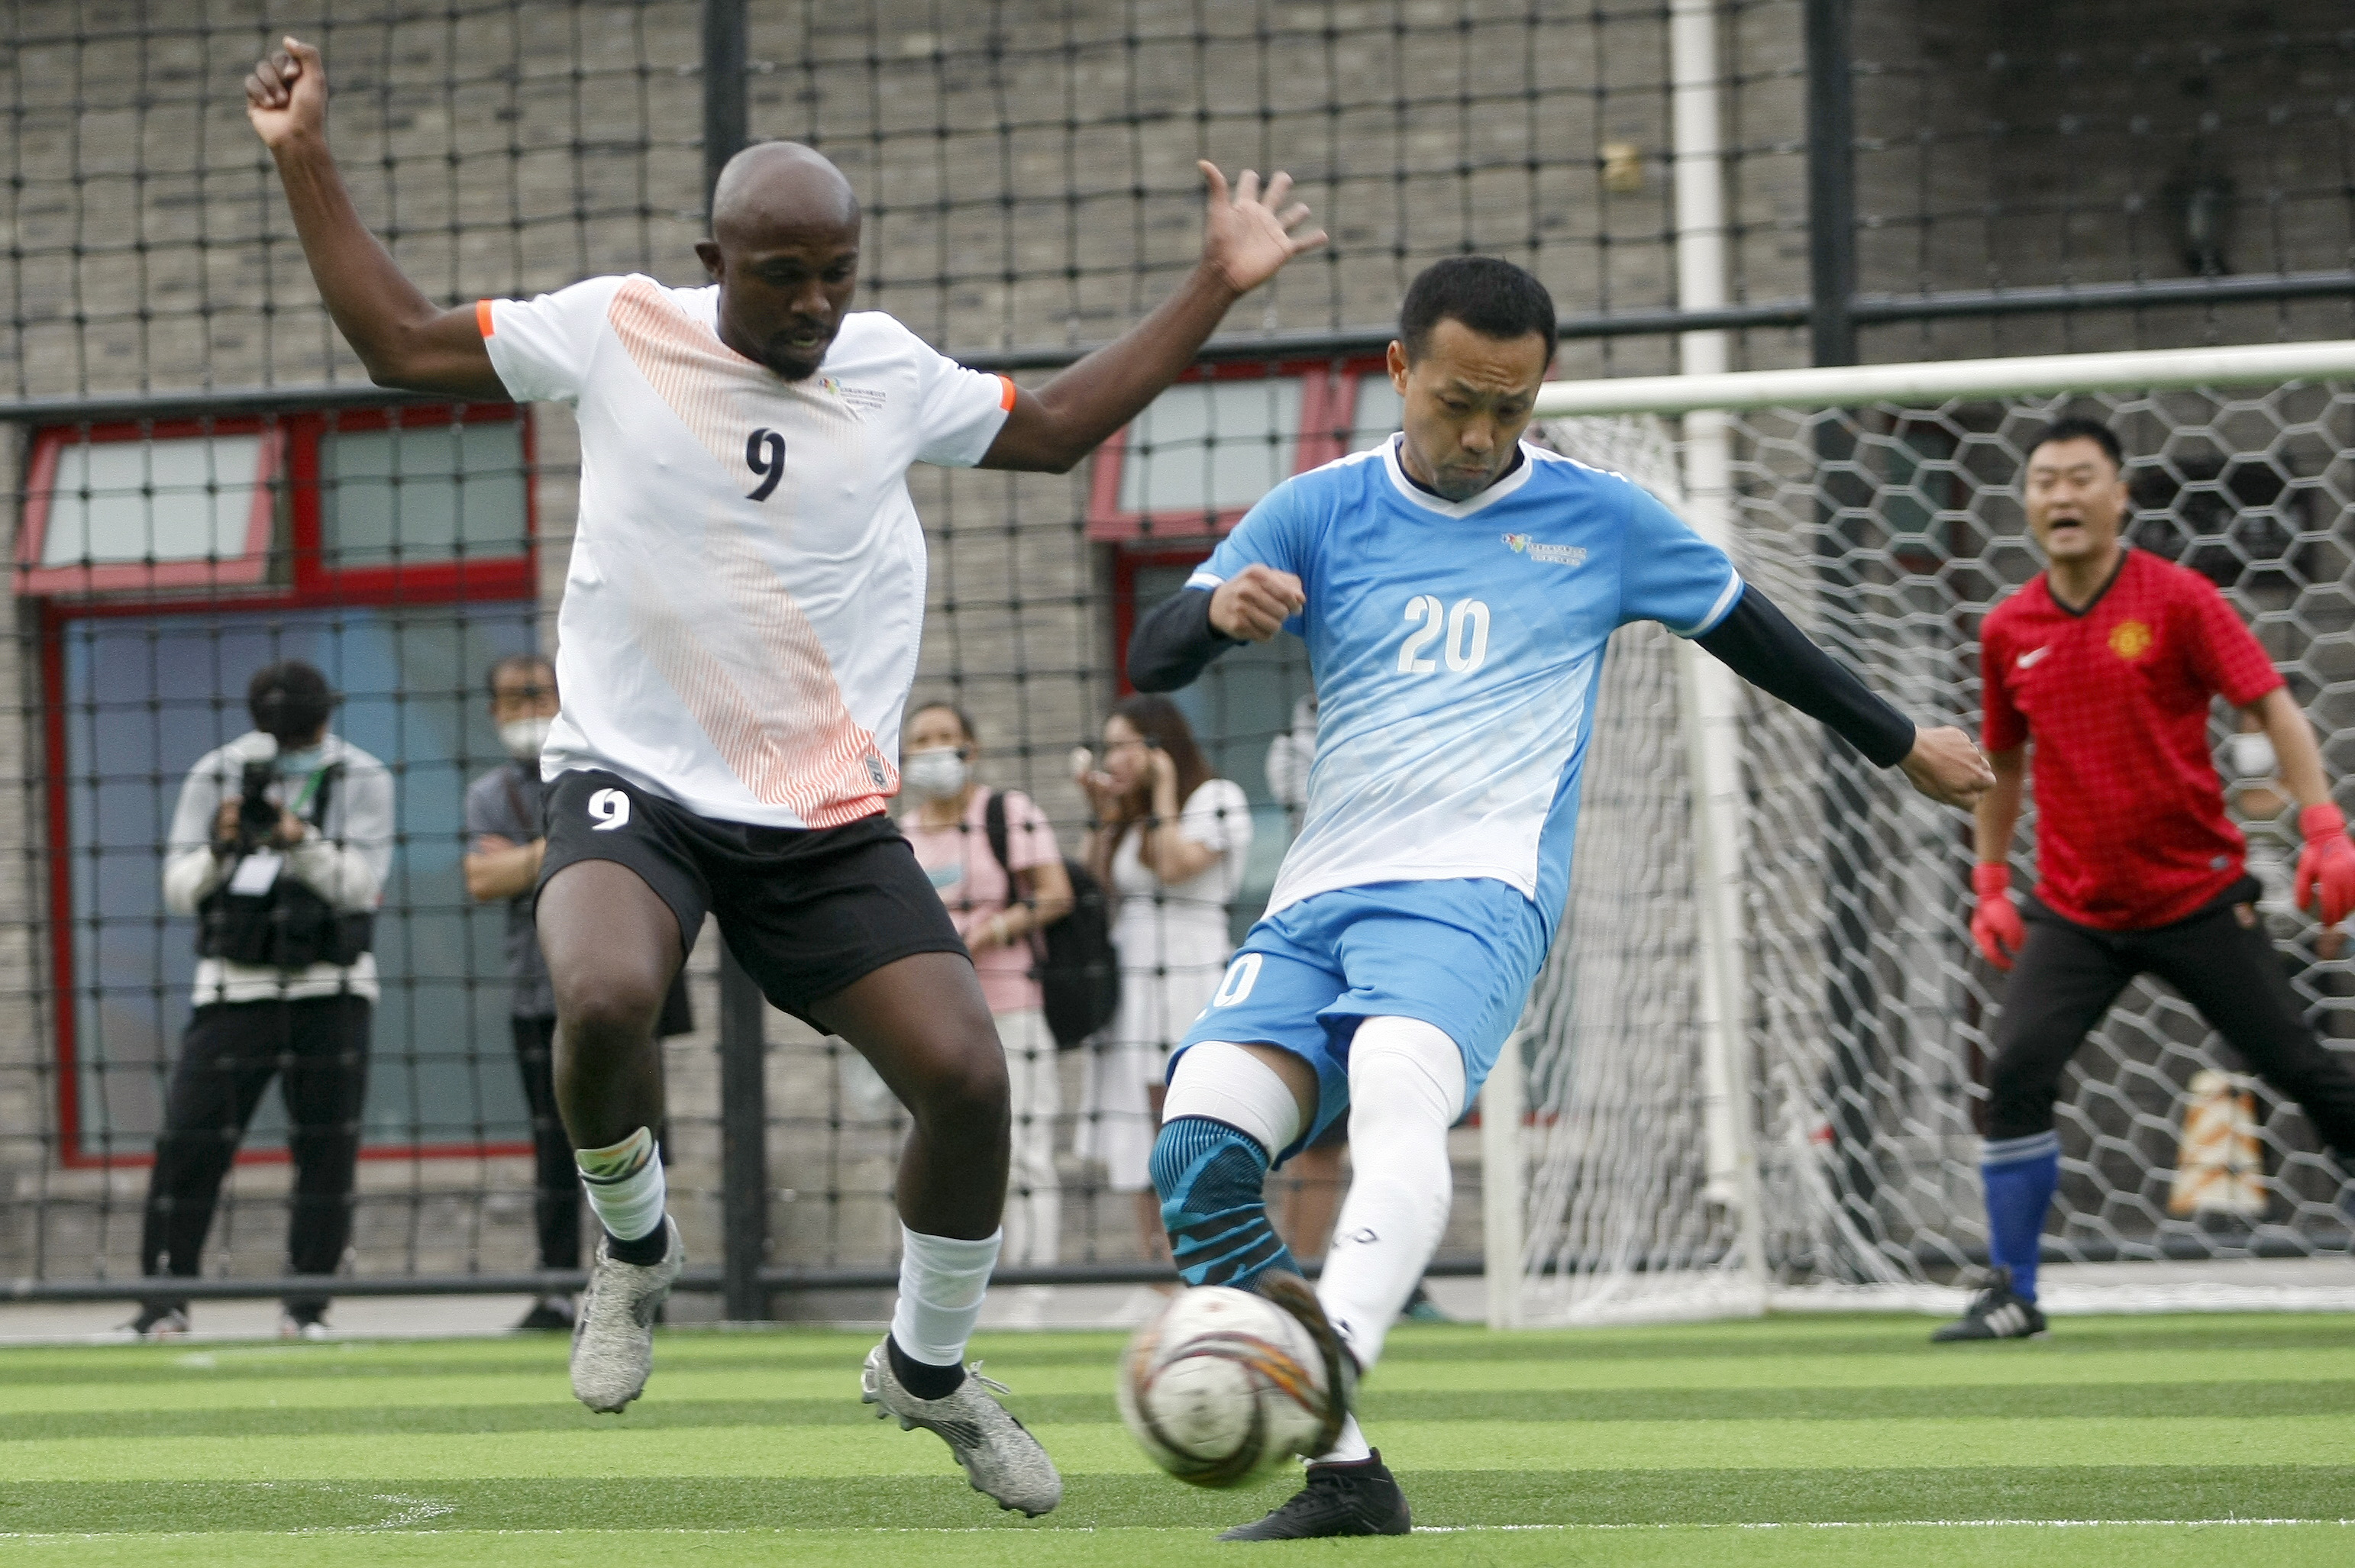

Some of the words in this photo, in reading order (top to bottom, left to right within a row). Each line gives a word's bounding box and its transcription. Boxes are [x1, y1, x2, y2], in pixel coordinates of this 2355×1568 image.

[746, 427, 786, 502] 9
[1397, 594, 1491, 673] 20
[588, 787, 631, 831] 9
[1195, 952, 1263, 1021] 0
